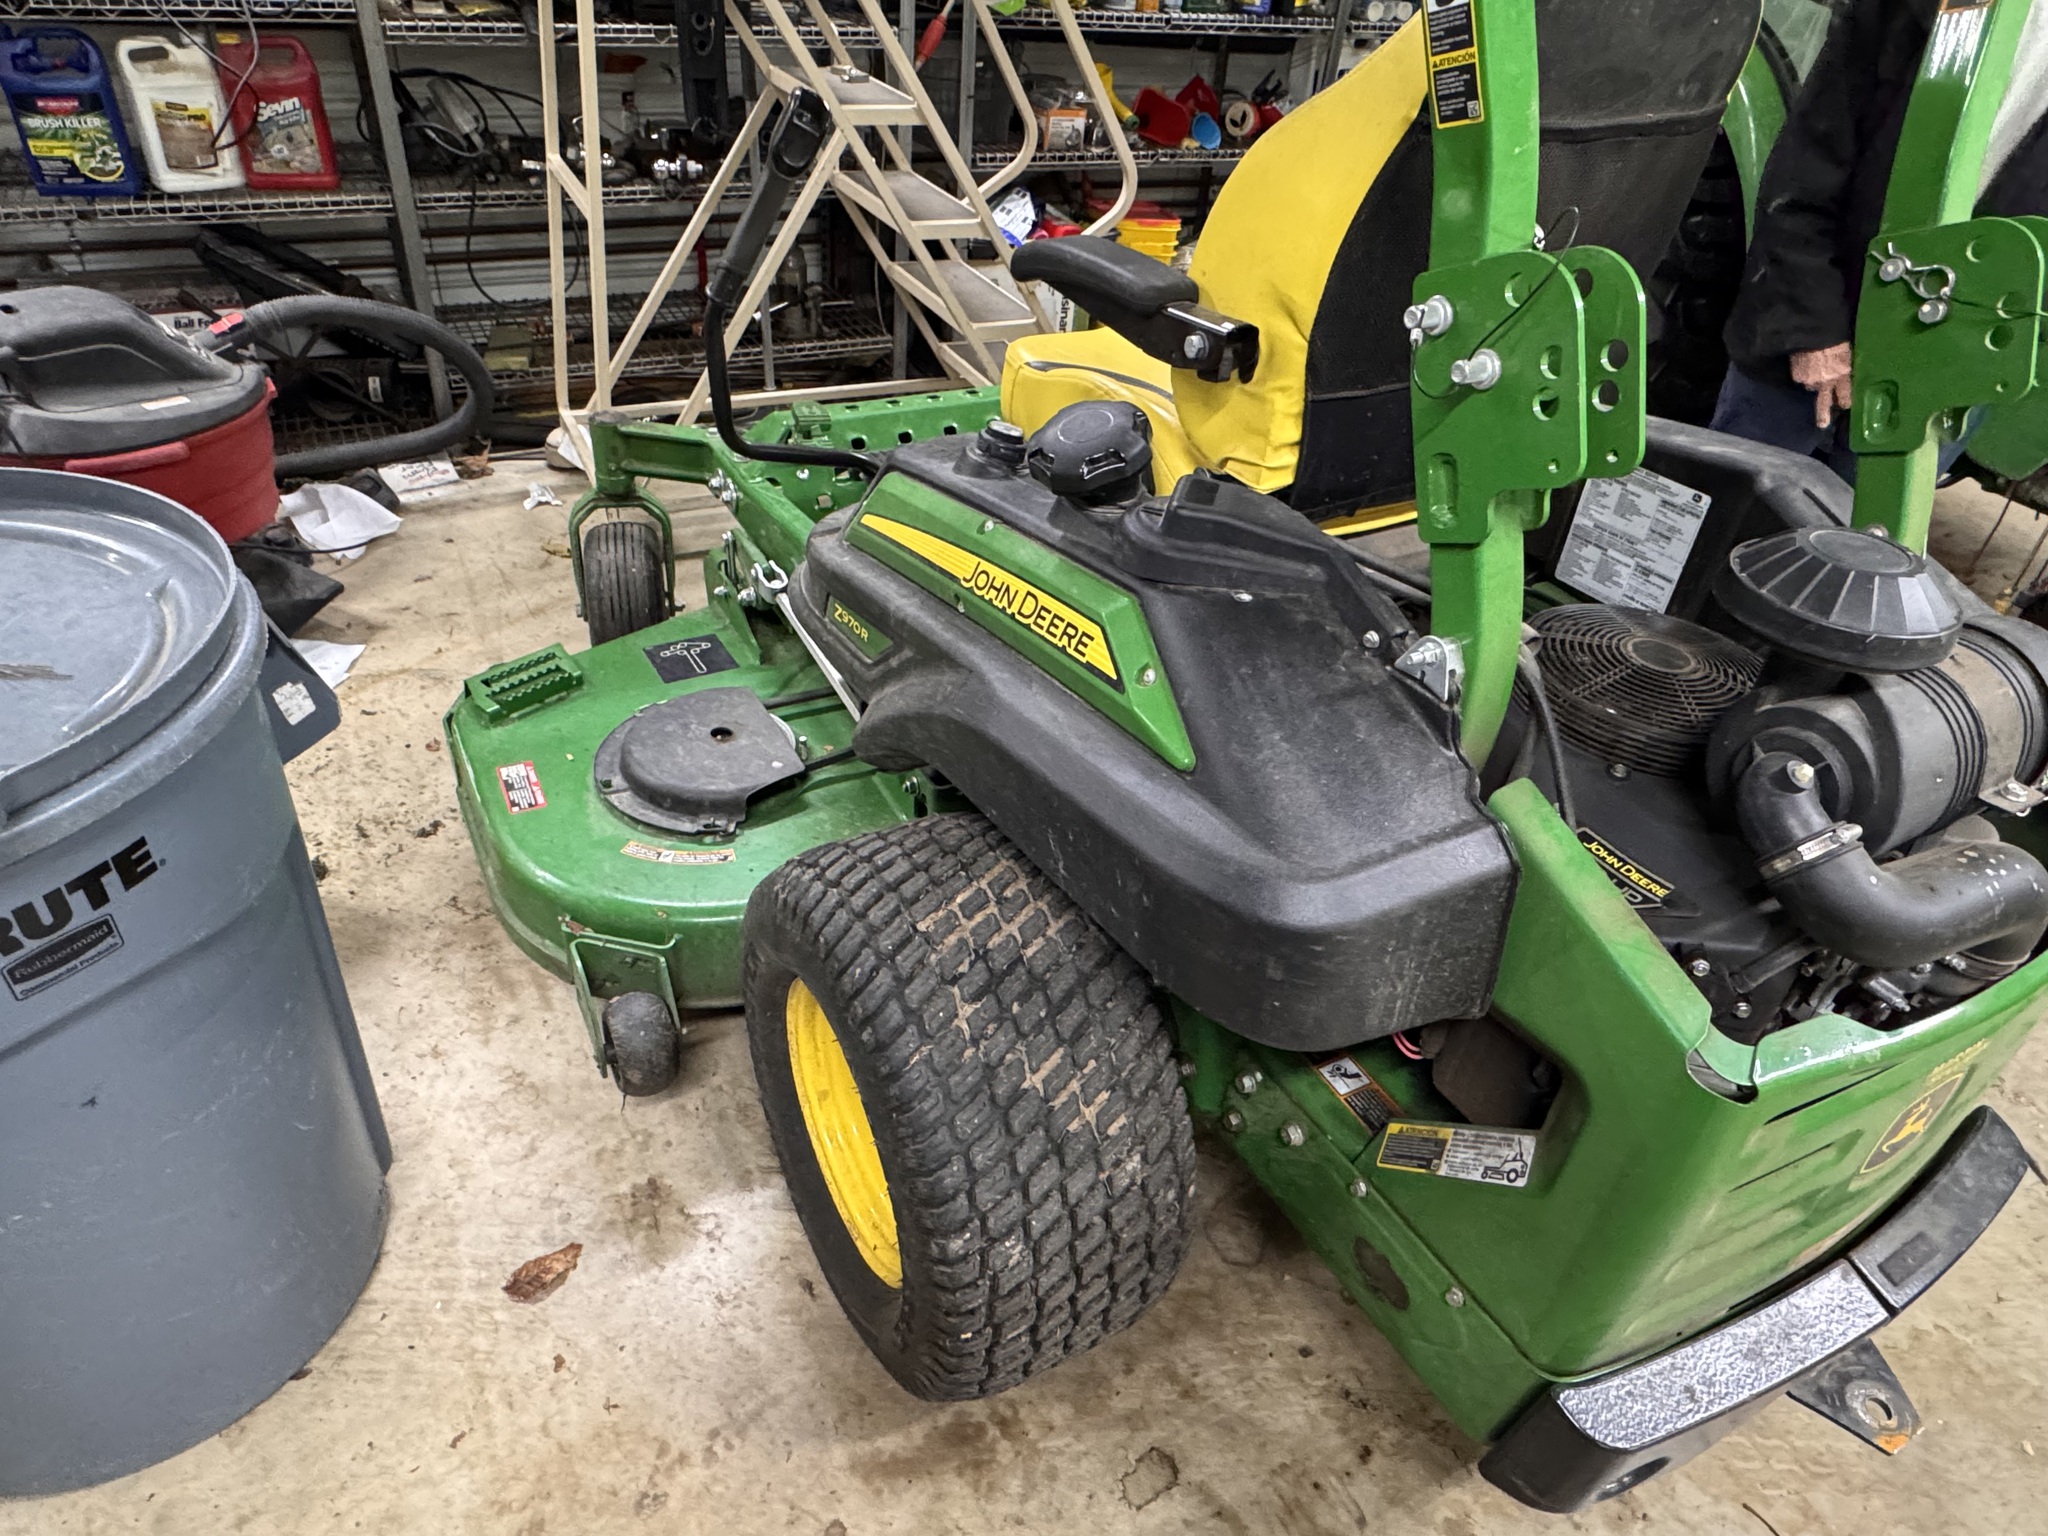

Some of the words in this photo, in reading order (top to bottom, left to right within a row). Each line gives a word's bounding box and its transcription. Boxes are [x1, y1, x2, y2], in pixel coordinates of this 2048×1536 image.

[26, 117, 64, 129] BRUSH
[65, 117, 102, 128] KILLER
[254, 97, 300, 122] Sevin
[834, 603, 869, 643] Z970R
[963, 561, 1018, 610] JOHN
[1017, 590, 1095, 658] DEERE
[1583, 841, 1623, 869] JOHN
[1620, 864, 1671, 898] DEERE
[15, 925, 109, 978] Rubbermaid
